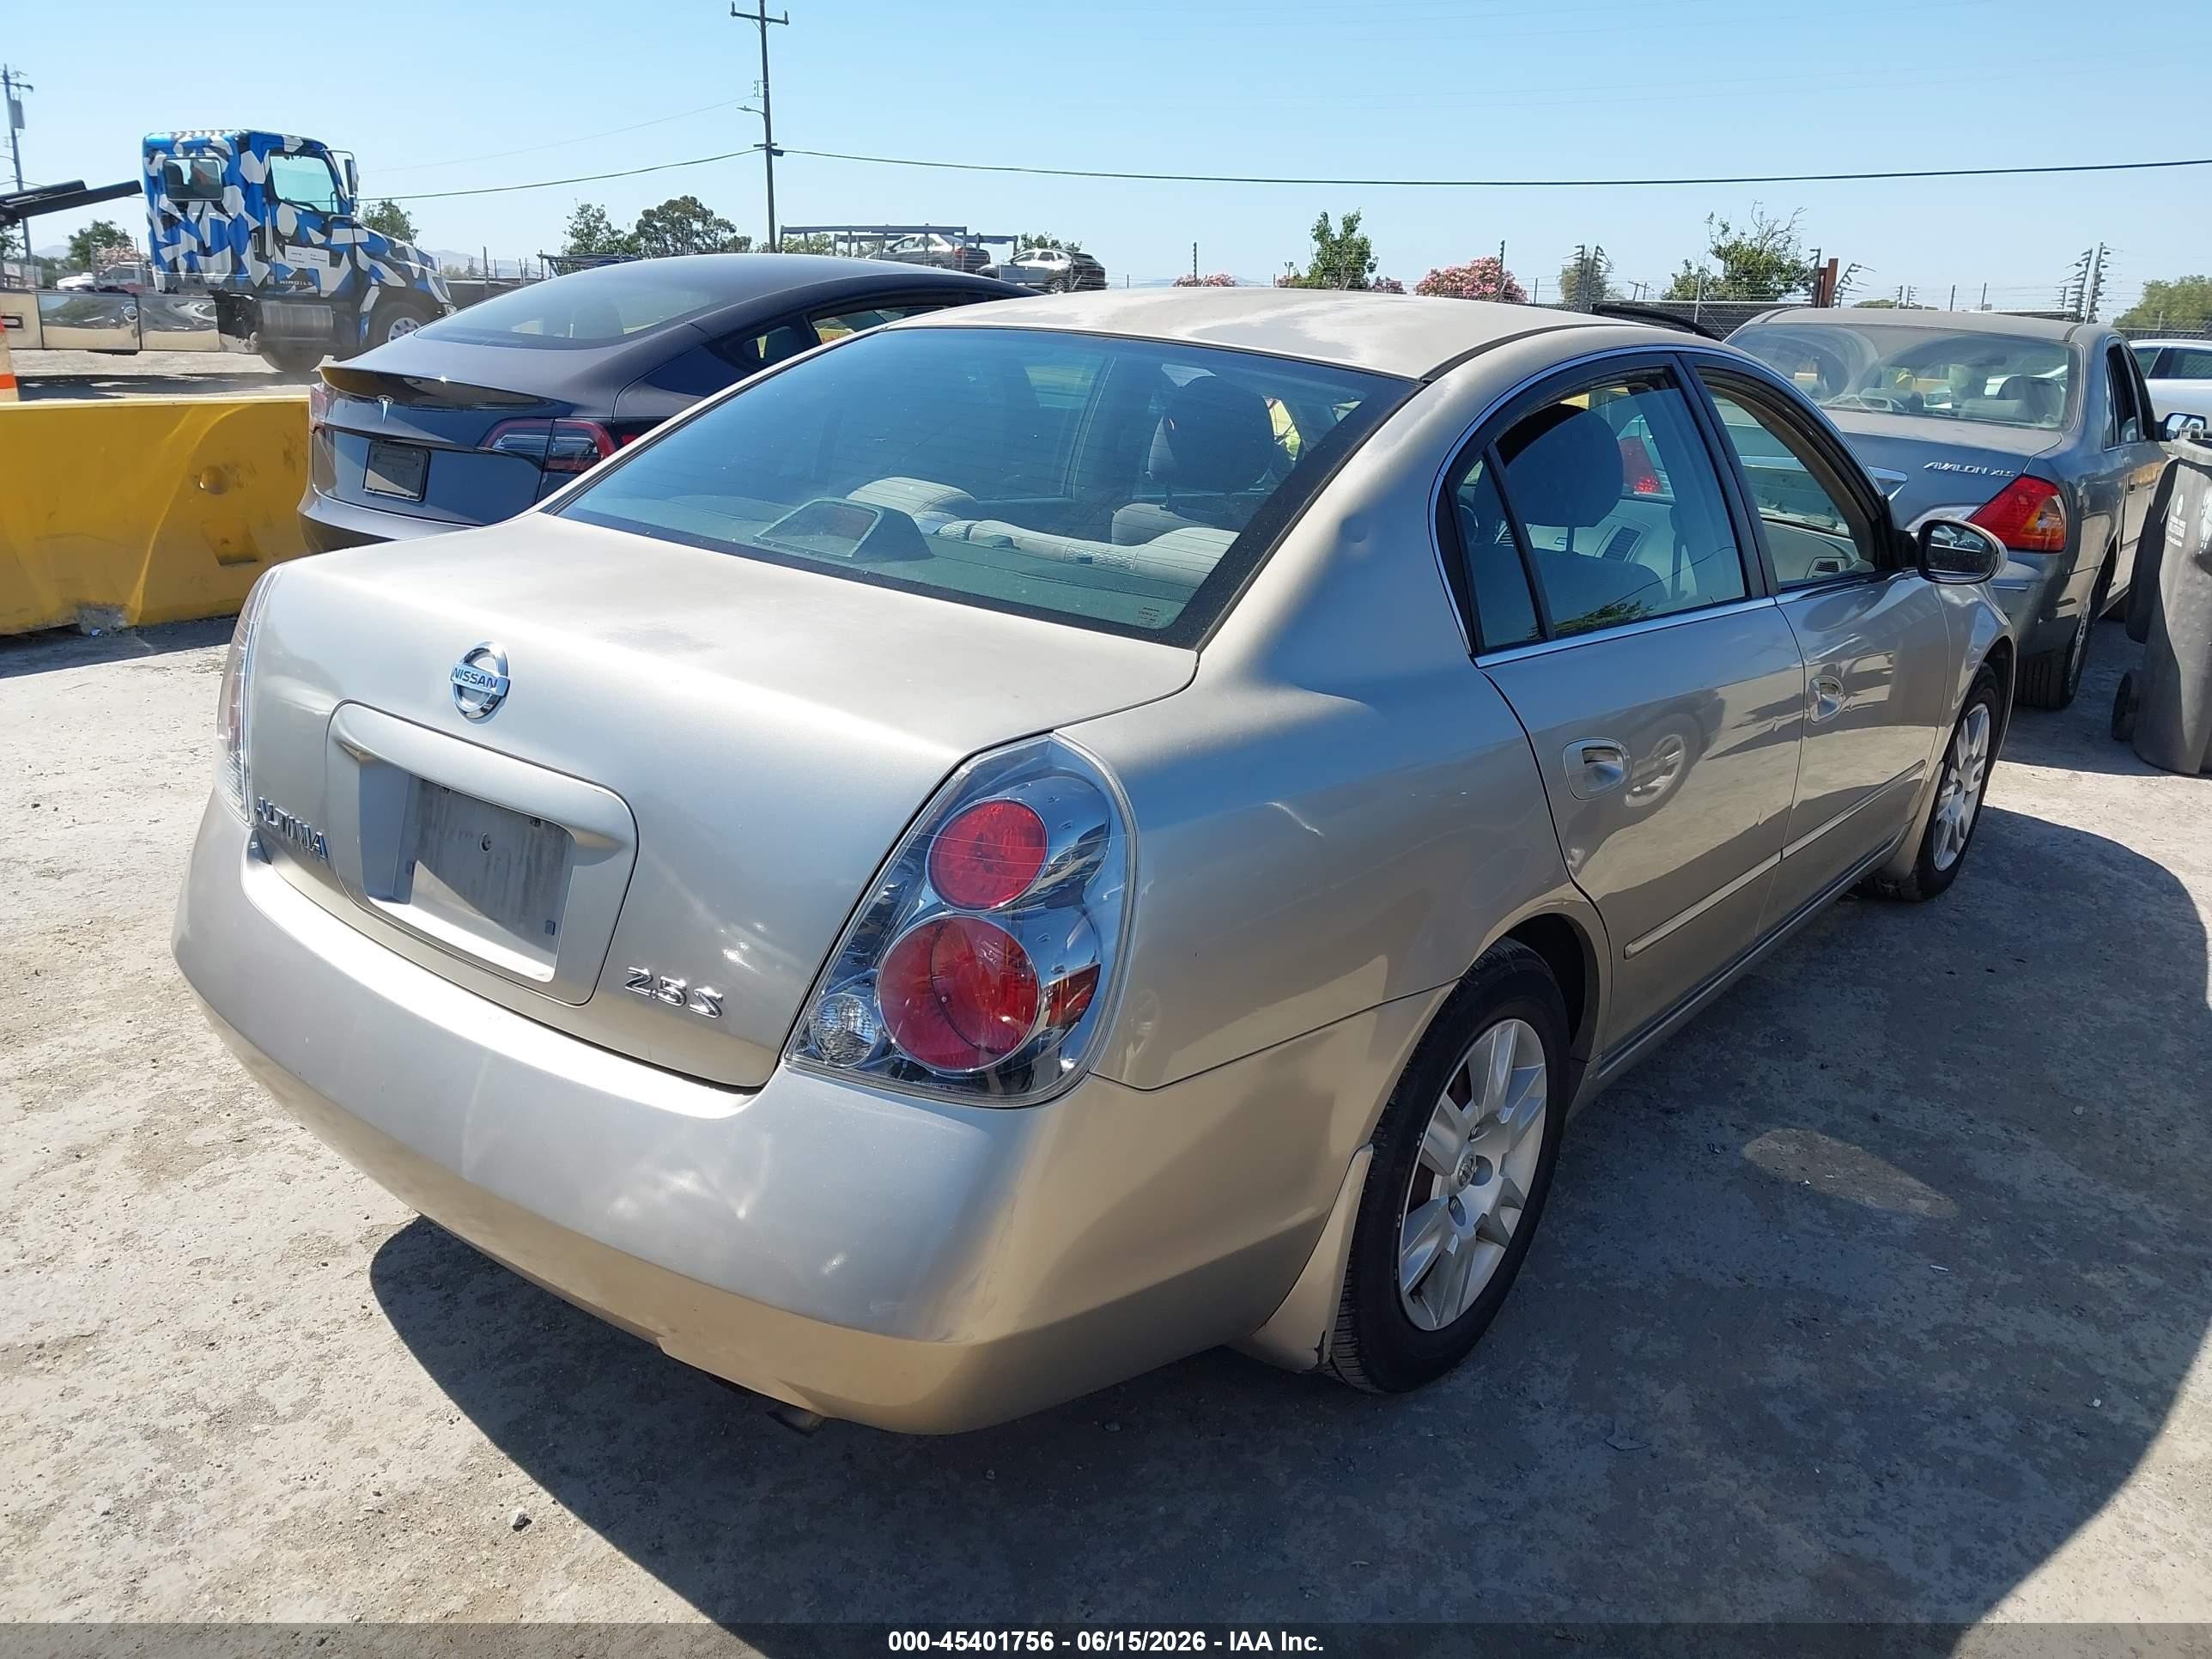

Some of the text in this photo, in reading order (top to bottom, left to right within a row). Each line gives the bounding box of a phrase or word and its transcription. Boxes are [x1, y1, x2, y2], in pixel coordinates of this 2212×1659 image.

[1923, 461, 2015, 477] AVALON XLS
[453, 666, 498, 689] NISSAN
[254, 796, 329, 860] ALTIMA
[624, 966, 723, 1018] 2.5 S
